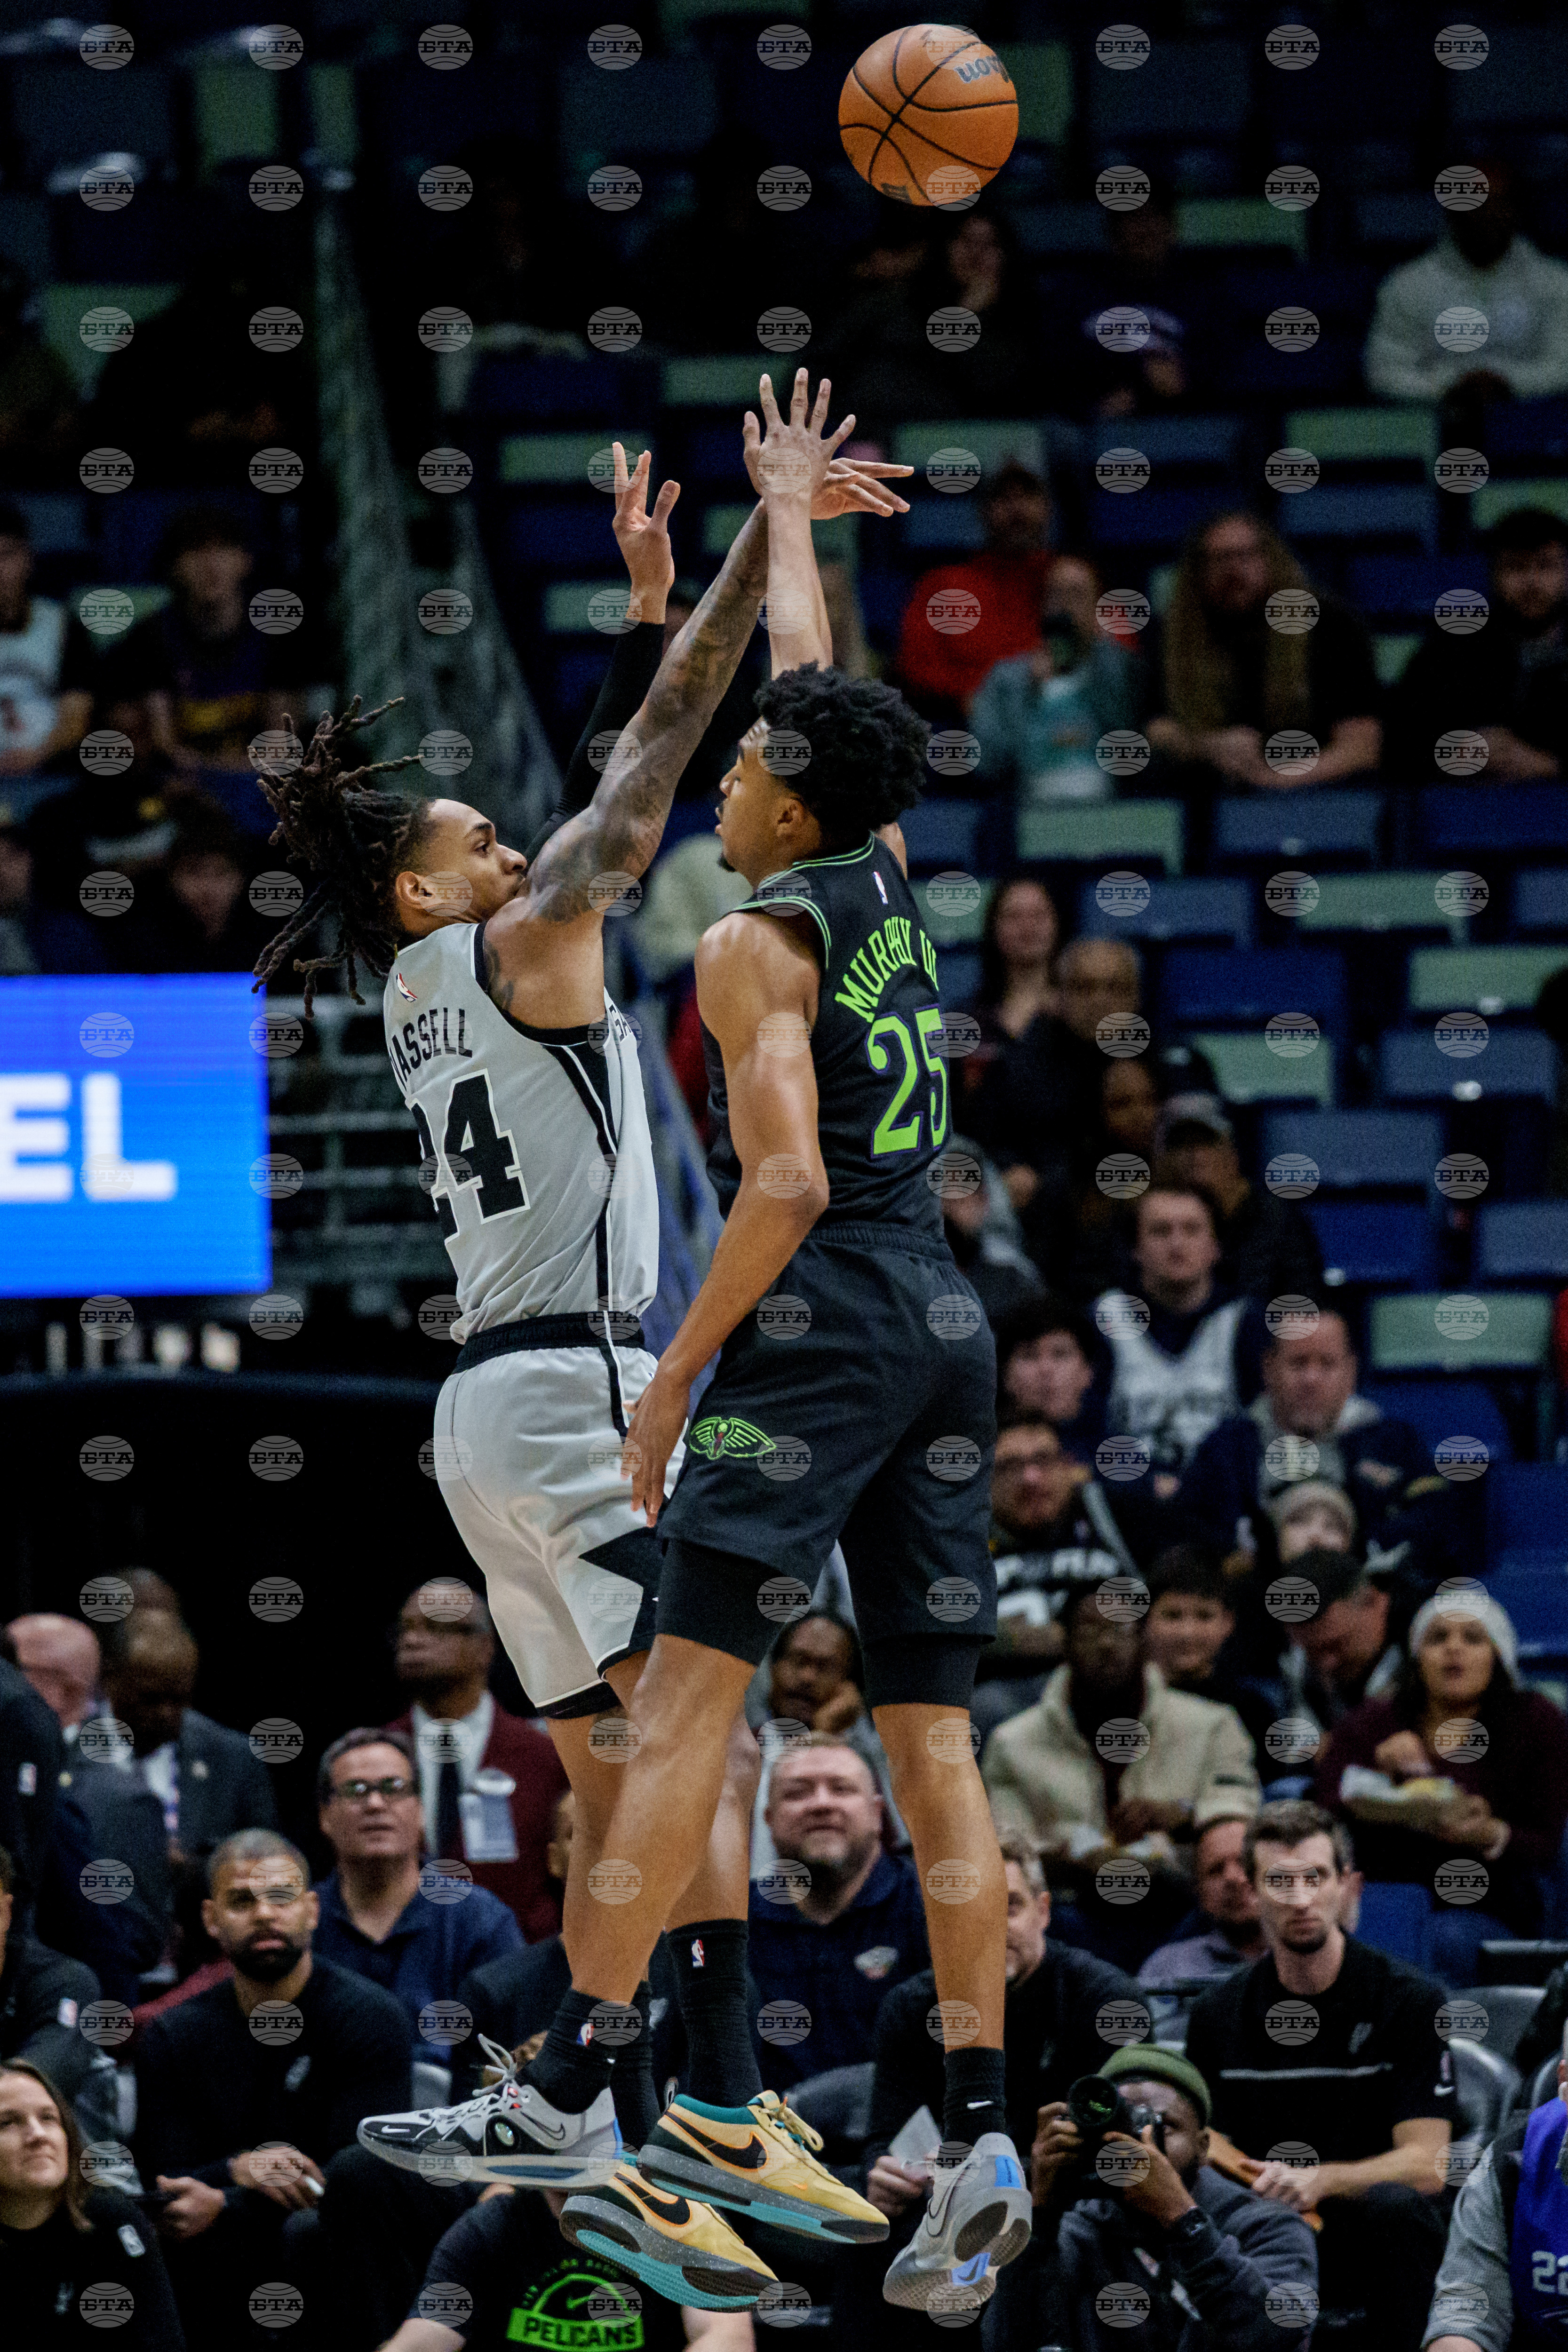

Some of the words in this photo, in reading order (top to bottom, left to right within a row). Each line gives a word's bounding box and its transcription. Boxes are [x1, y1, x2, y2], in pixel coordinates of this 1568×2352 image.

[835, 916, 917, 1023] MURPHY
[0, 1070, 180, 1204] EL
[864, 1003, 947, 1158] 25
